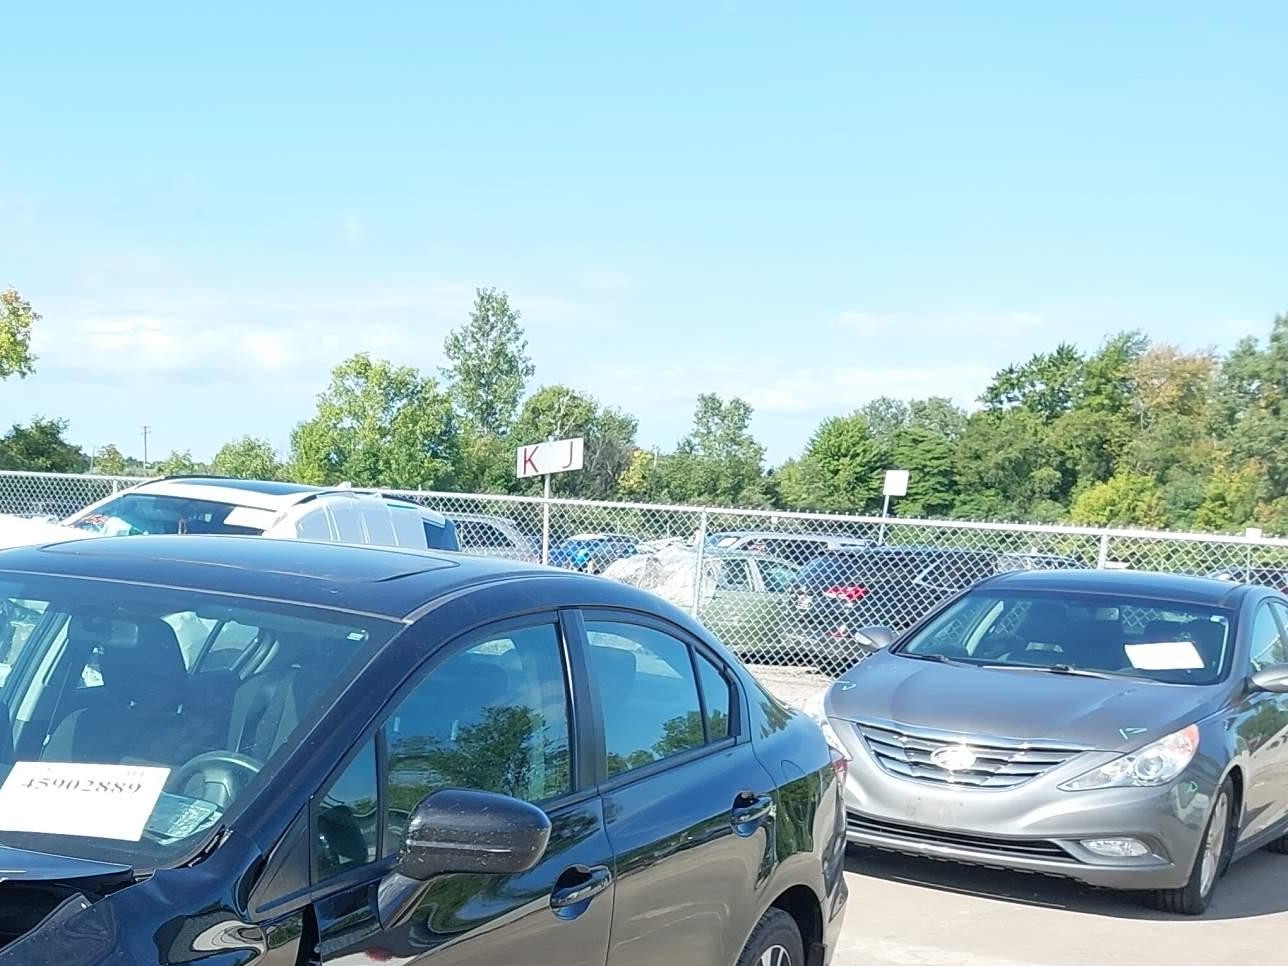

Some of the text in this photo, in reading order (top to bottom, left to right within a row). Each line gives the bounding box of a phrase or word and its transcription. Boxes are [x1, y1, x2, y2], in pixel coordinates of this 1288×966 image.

[523, 441, 573, 475] K J
[21, 777, 143, 793] 45902889
